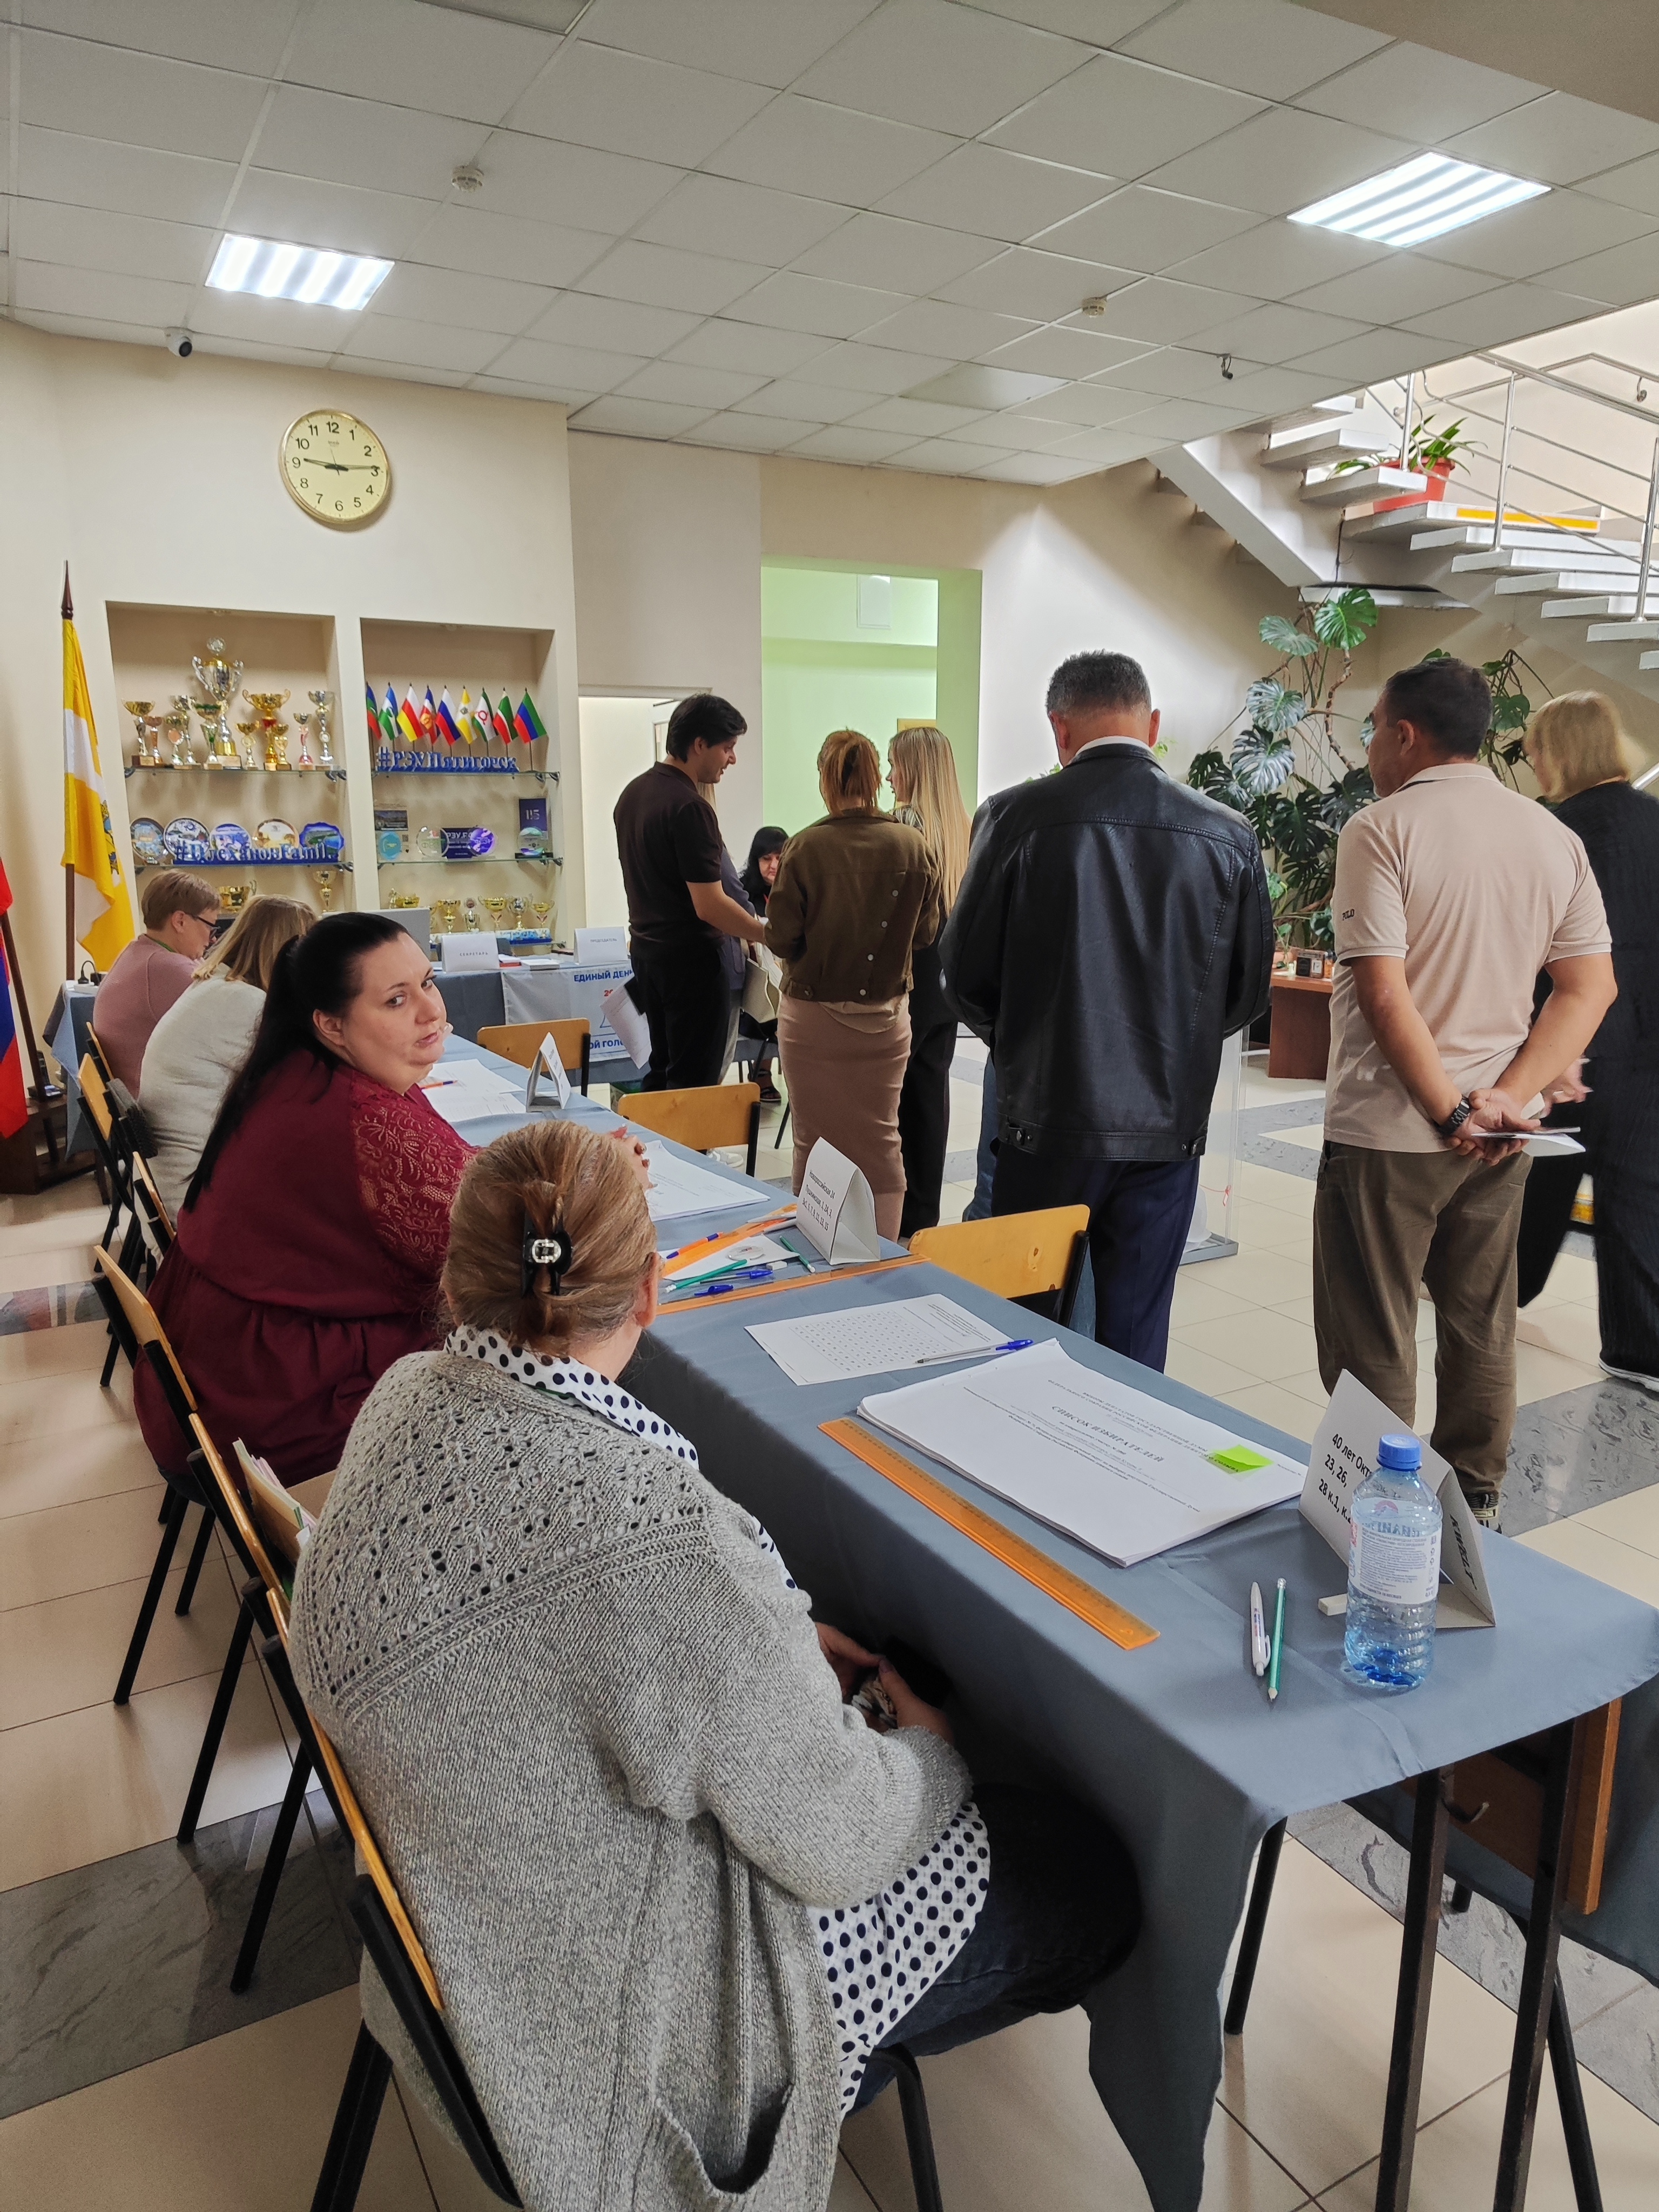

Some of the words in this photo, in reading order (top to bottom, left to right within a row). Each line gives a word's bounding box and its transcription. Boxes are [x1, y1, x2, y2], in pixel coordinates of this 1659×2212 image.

[308, 424, 318, 436] 11
[326, 421, 340, 434] 12
[349, 429, 355, 441] 1
[295, 437, 310, 449] 10
[363, 445, 372, 457] 2
[292, 457, 301, 468] 9
[370, 465, 379, 476] 3
[300, 477, 308, 488] 8
[366, 484, 374, 495] 4
[316, 493, 323, 504] 7
[354, 497, 361, 508] 5
[335, 500, 343, 511] 6
[574, 970, 611, 982] ЕДИНЫЙ
[1051, 1405, 1092, 1427] СПИСОК
[1091, 1424, 1164, 1462] ИЗБИРАТЕЛЕЙ
[1332, 1434, 1343, 1449] 40
[1341, 1445, 1356, 1462] лет
[1355, 1456, 1372, 1477] Окт
[1325, 1454, 1335, 1475] 23,
[1337, 1466, 1348, 1488] 26,
[1319, 1478, 1328, 1496] 28
[1327, 1491, 1340, 1513] к.1,
